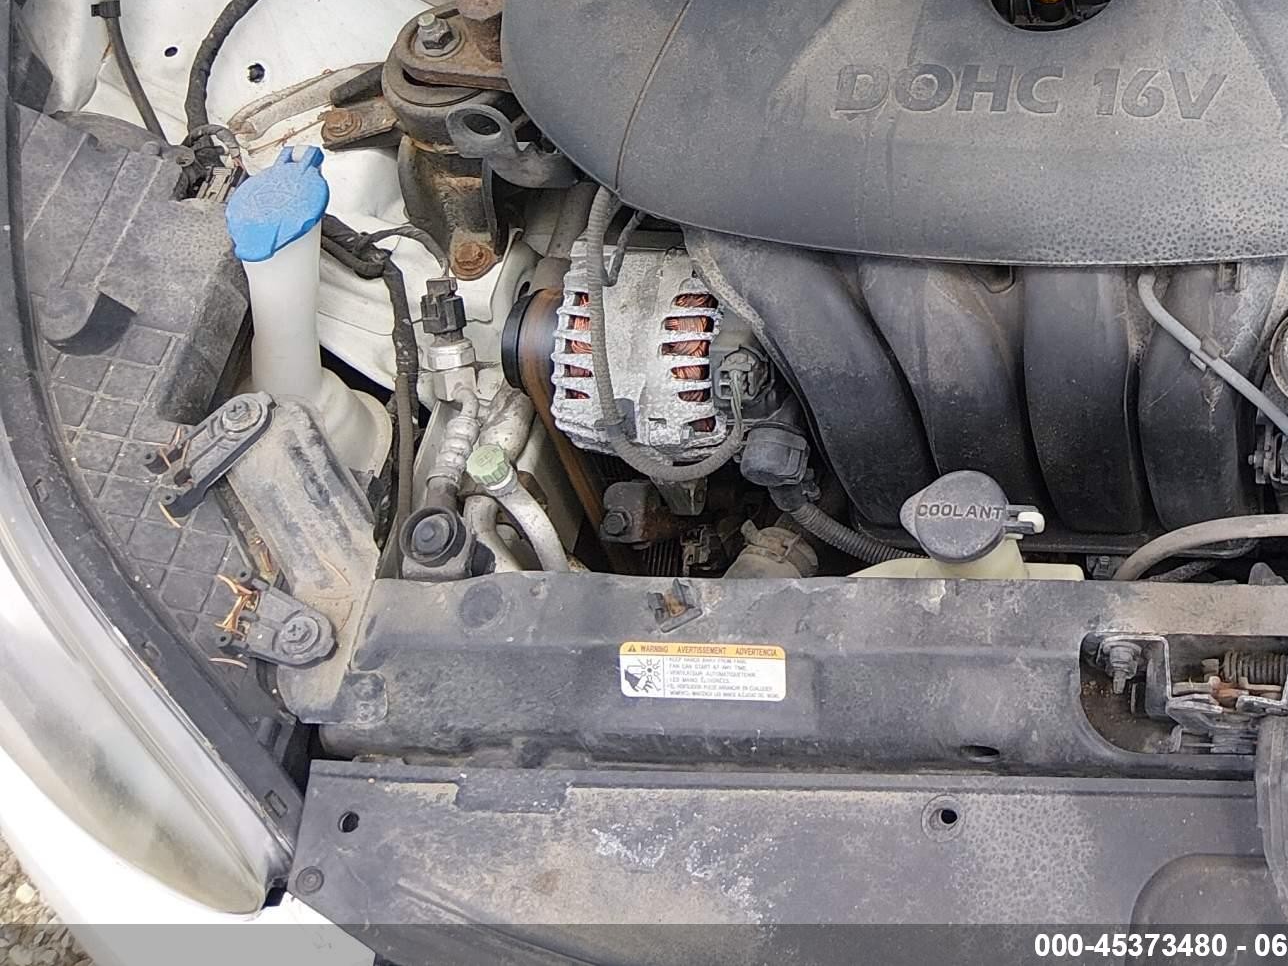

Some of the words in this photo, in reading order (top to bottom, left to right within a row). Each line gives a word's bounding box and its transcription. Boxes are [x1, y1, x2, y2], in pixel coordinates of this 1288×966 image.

[834, 62, 1066, 115] DOHC
[1093, 66, 1228, 120] 16V
[917, 503, 1004, 520] COOLANT
[677, 647, 727, 655] AVERTISSEMENT
[735, 648, 778, 656] ADVERTENCIA
